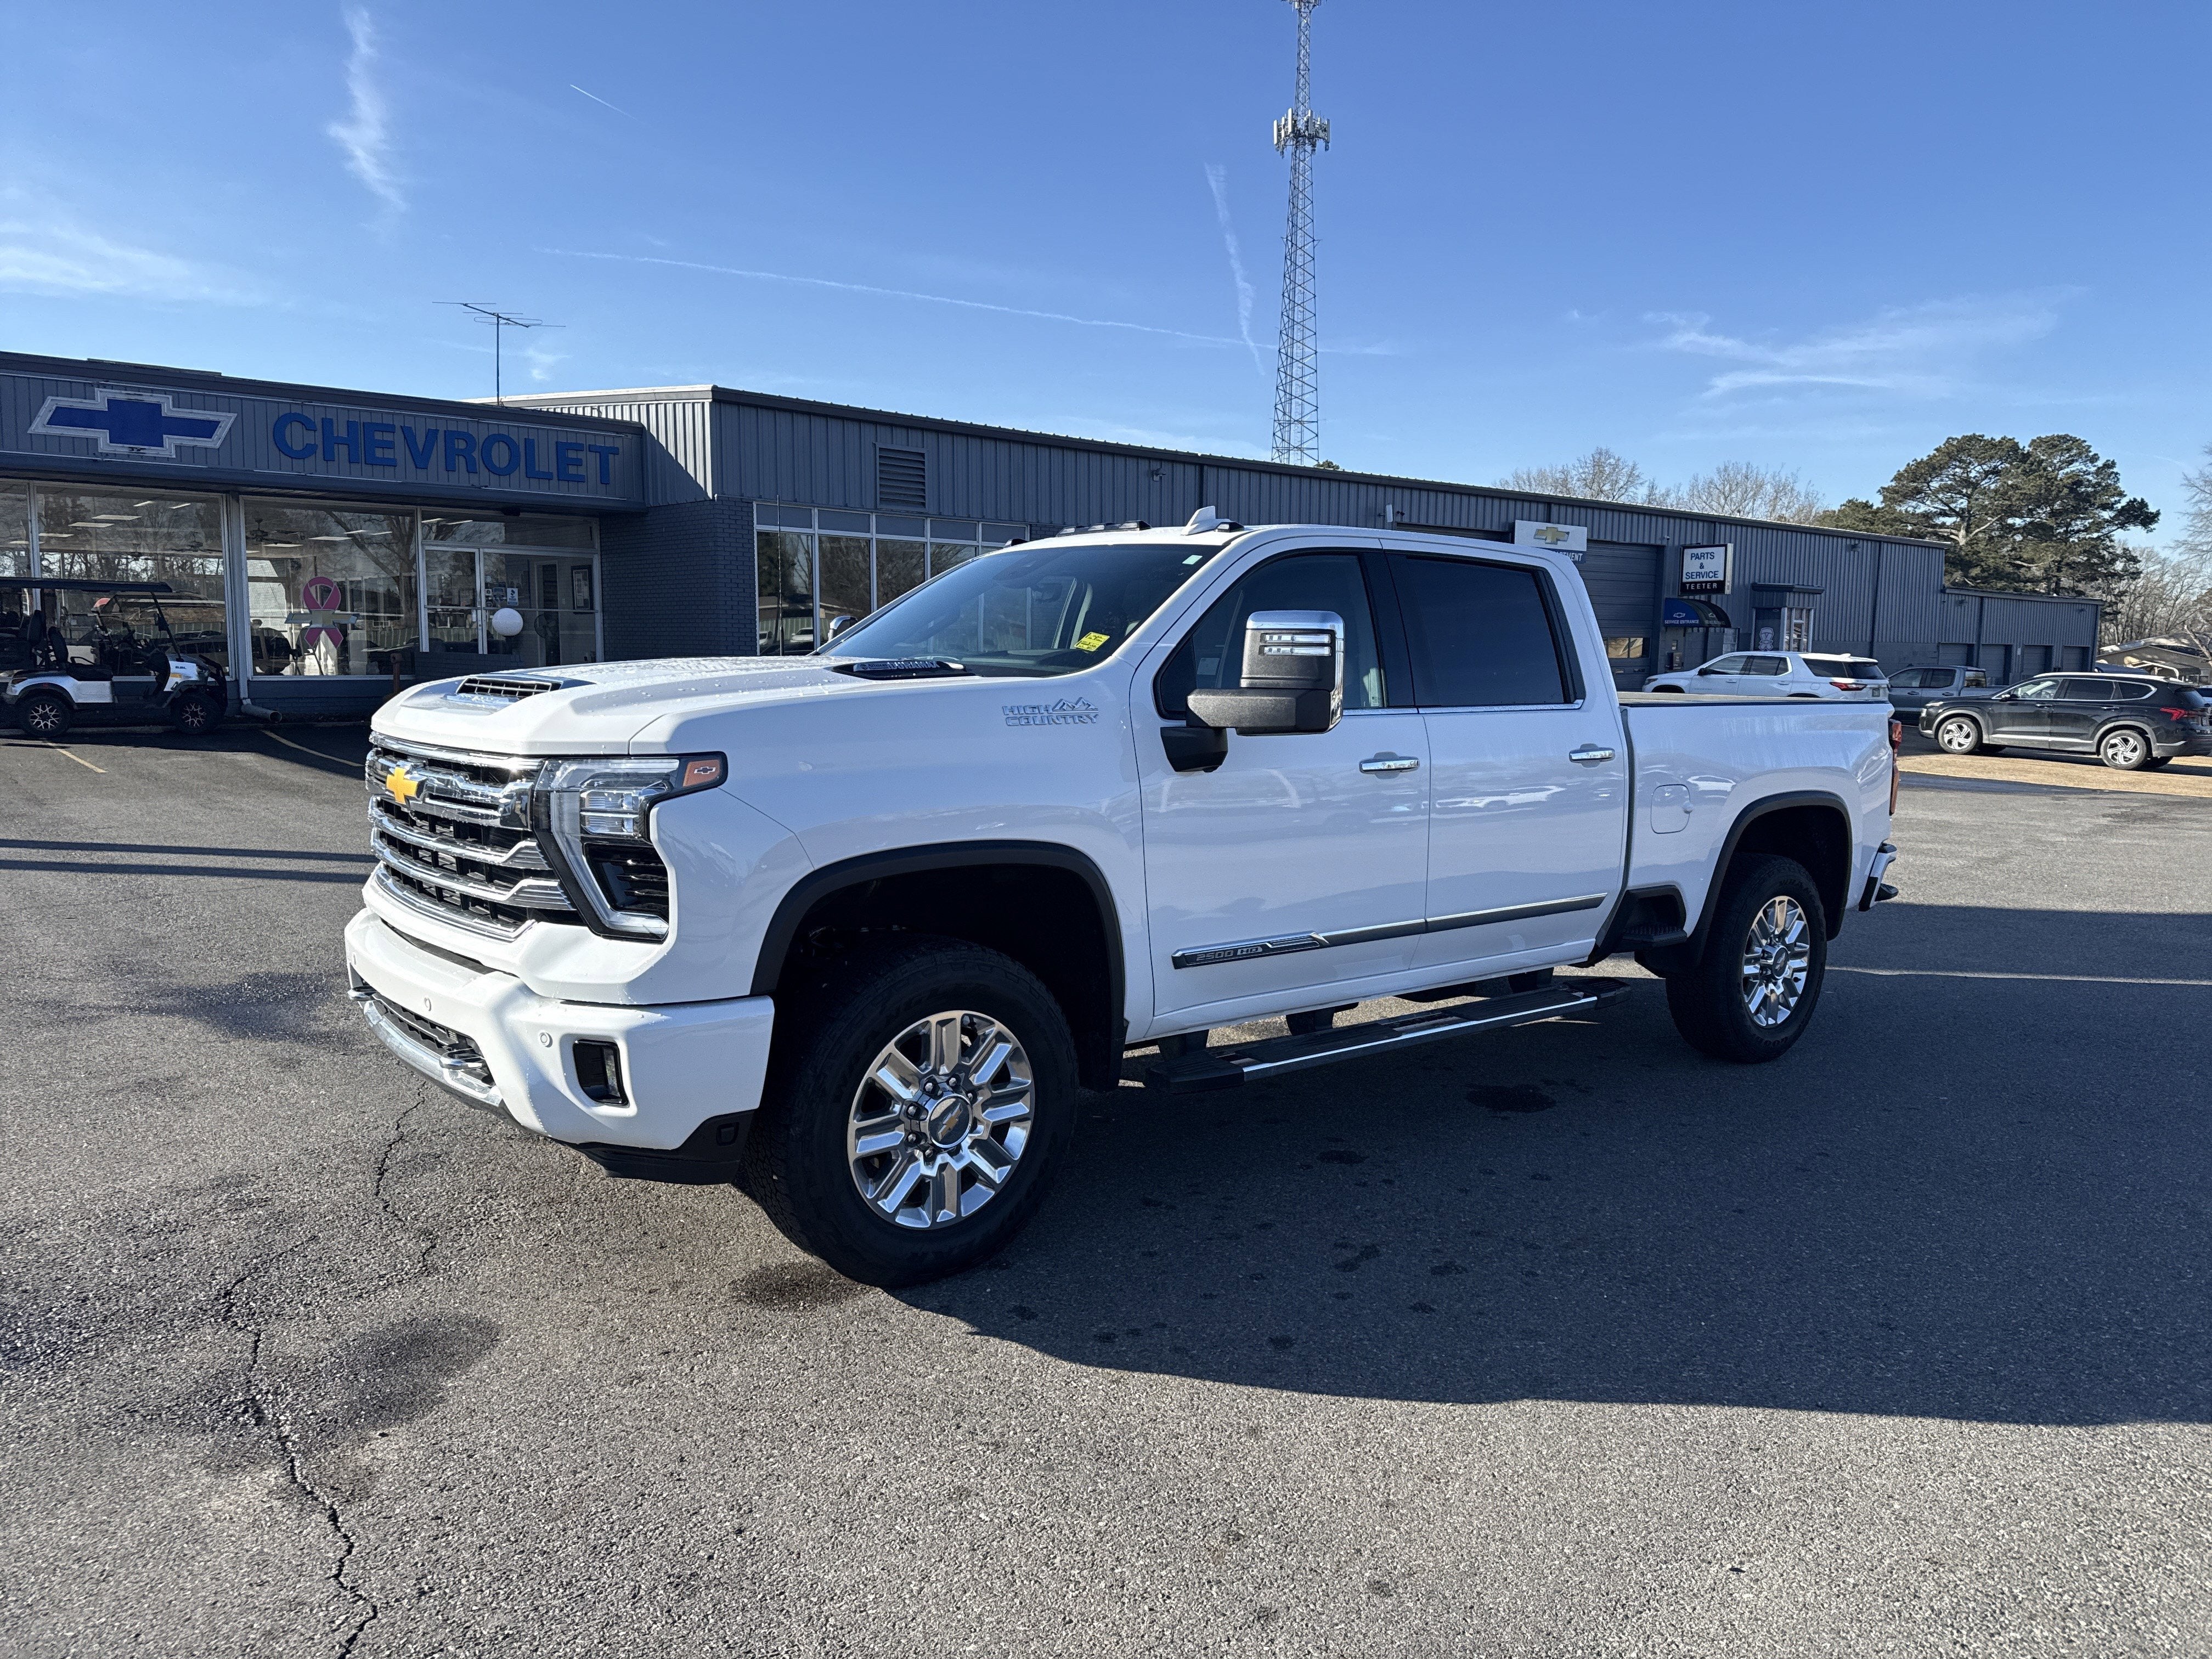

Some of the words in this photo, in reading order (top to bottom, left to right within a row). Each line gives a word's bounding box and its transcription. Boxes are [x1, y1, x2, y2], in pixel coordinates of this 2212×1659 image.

[273, 413, 620, 484] CHEVROLET
[1690, 552, 1715, 560] PARTS
[1685, 571, 1719, 579] SERVICE
[887, 661, 940, 670] DURAMAX
[1002, 704, 1053, 715] HIGH
[1006, 714, 1099, 726] COUNTRY
[1197, 950, 1234, 961] 2500
[1238, 946, 1262, 956] HD
